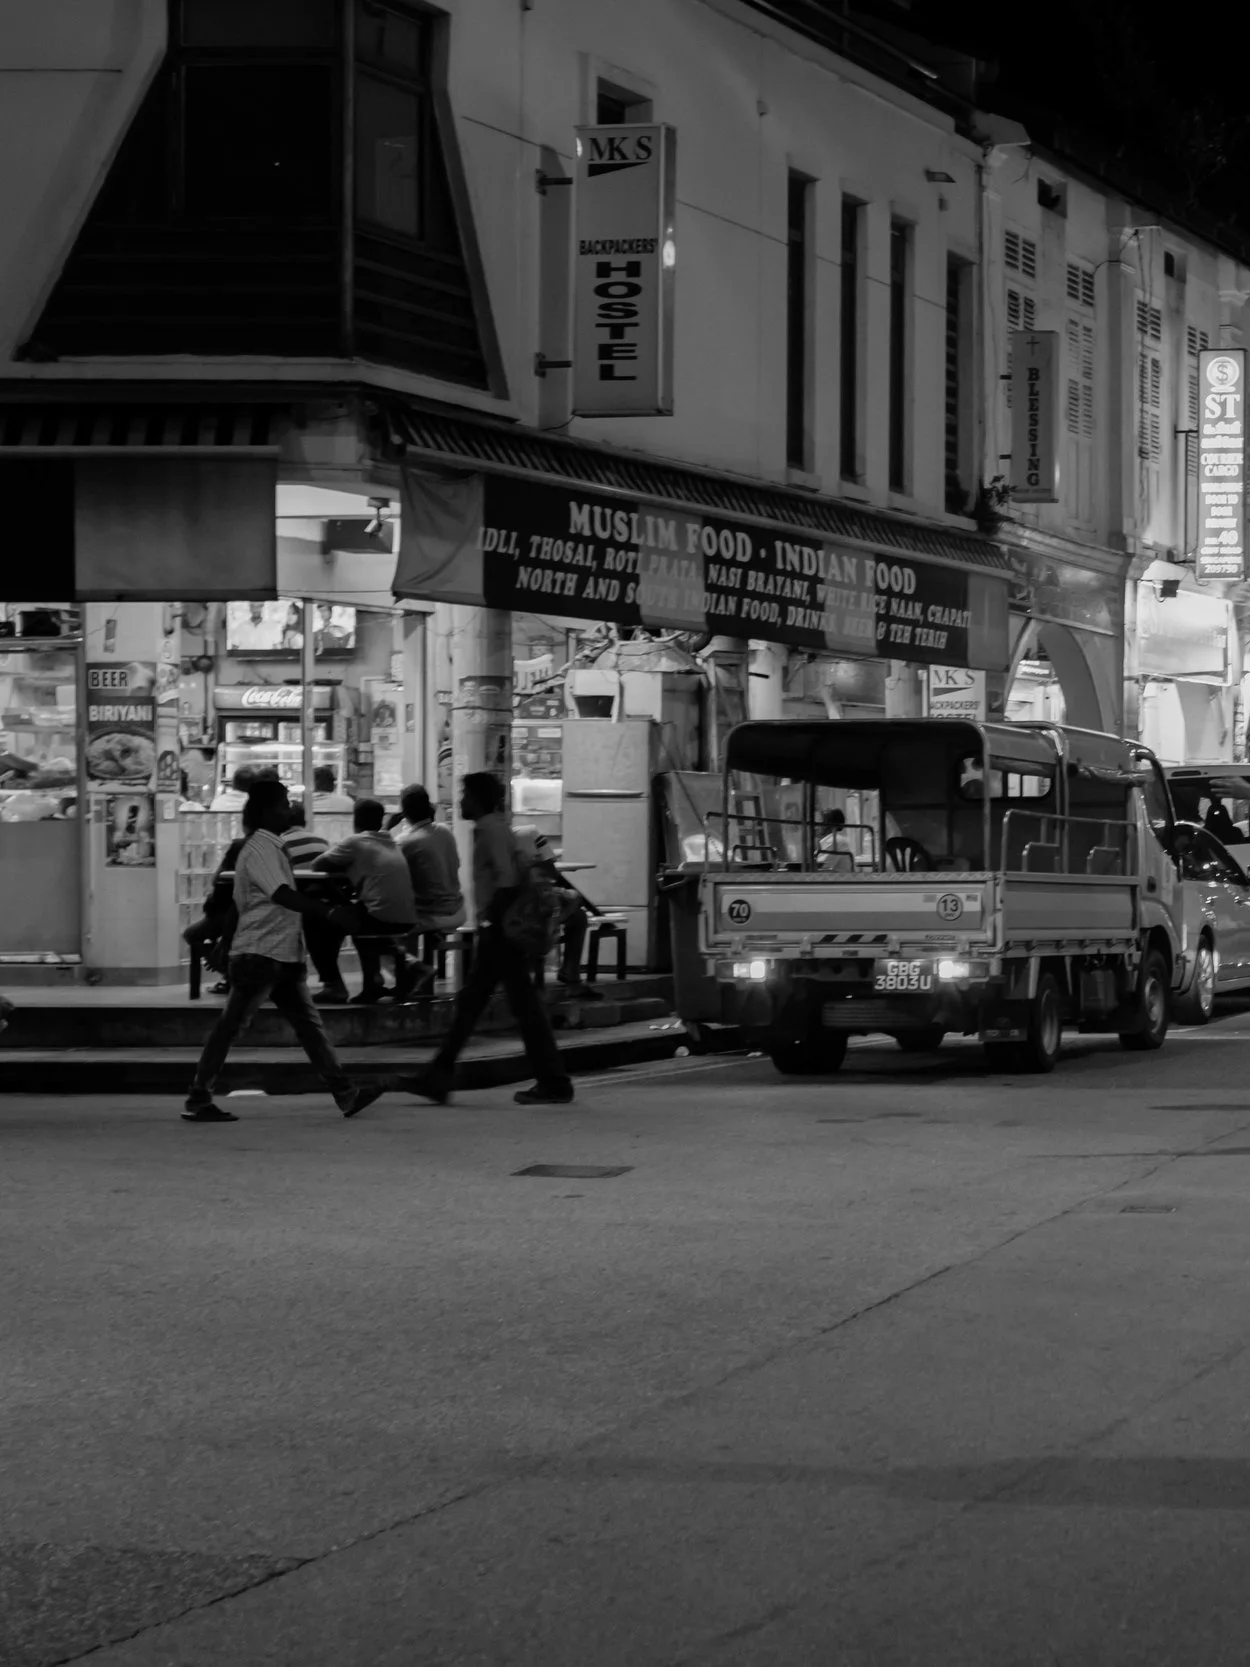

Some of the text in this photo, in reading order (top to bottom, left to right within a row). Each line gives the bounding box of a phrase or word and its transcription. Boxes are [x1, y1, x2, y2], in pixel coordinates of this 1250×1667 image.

[588, 135, 653, 162] MKS
[594, 261, 642, 381] HOSTEL
[1205, 394, 1240, 418] ST
[1027, 367, 1040, 487] BLESSING
[568, 500, 917, 596] MUSLIM FOOD INDIAN FOOD
[529, 534, 599, 572] THOSAI,
[603, 547, 641, 574] ROTI
[708, 563, 744, 590] NASI
[515, 565, 579, 597] NORTH
[582, 576, 621, 602] AND
[740, 598, 784, 629] FOOD,
[890, 623, 914, 645] TEH
[90, 671, 129, 688] BEER
[89, 704, 154, 722] BIRIYANI
[731, 903, 749, 917] 70
[941, 898, 959, 912] 13
[887, 961, 921, 976] GBG
[874, 975, 932, 991] 3803U
